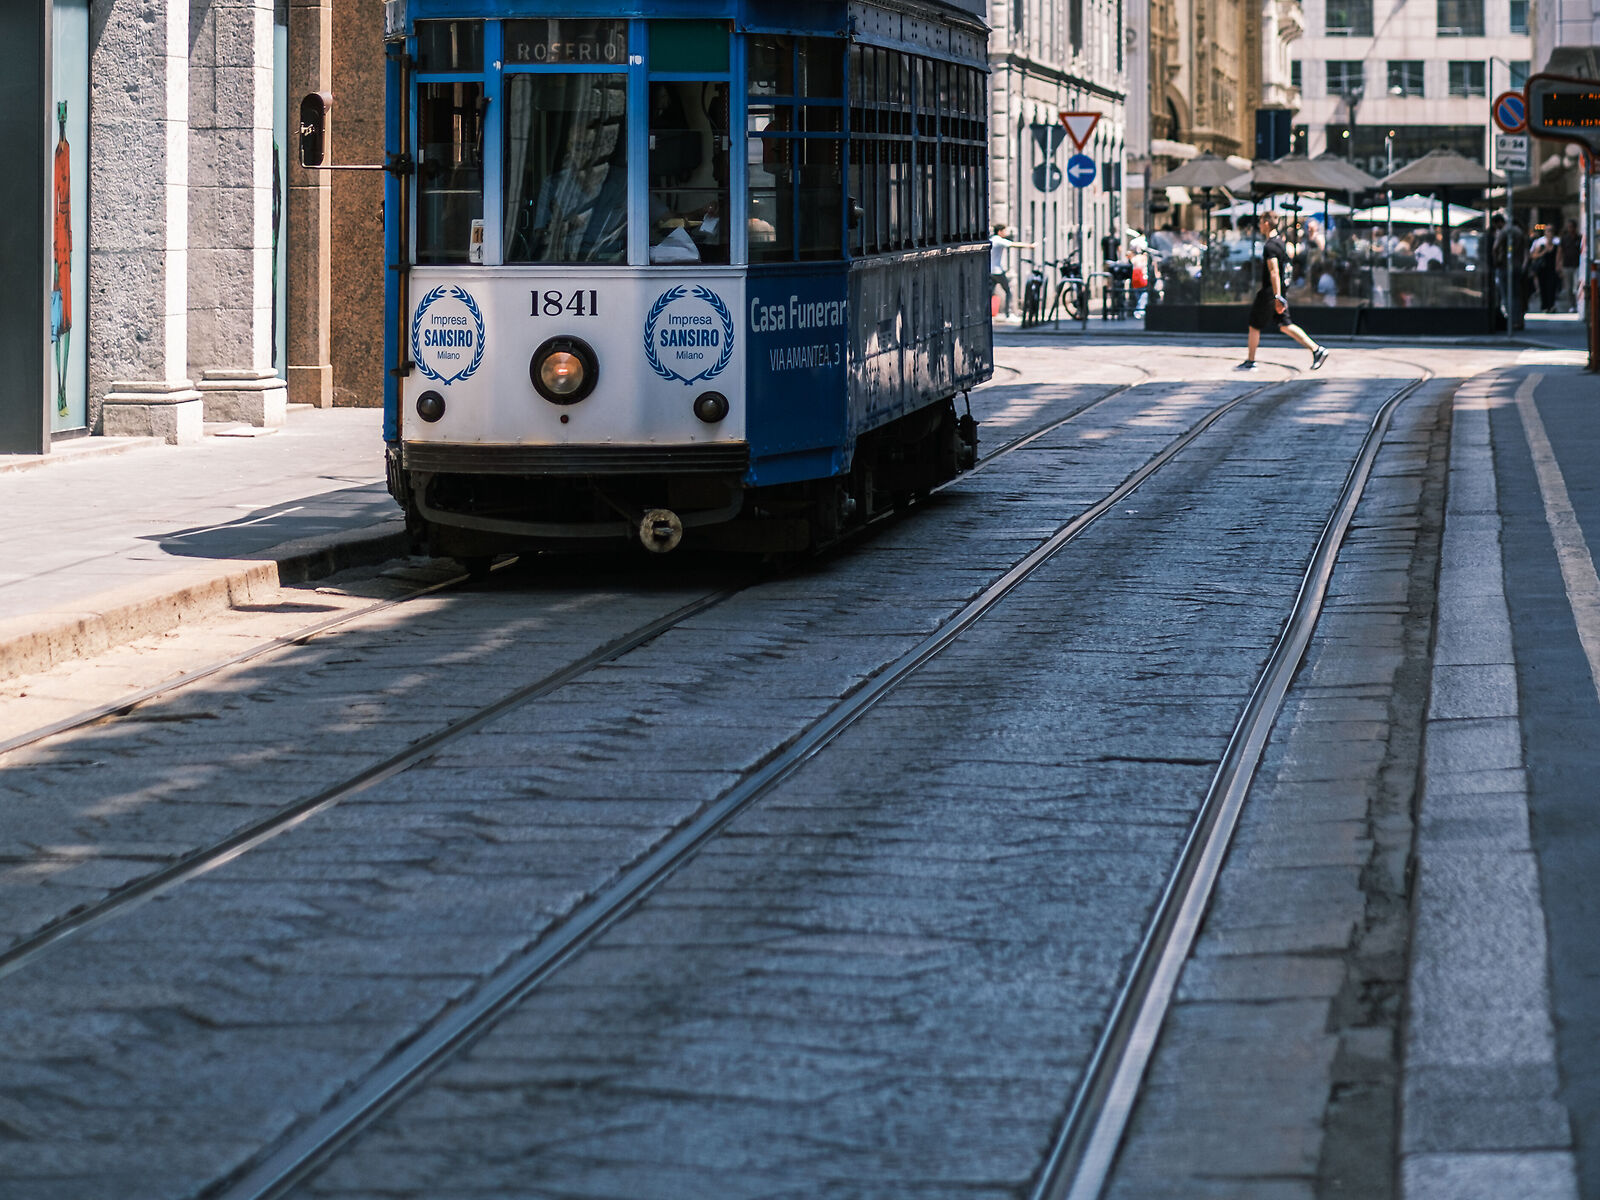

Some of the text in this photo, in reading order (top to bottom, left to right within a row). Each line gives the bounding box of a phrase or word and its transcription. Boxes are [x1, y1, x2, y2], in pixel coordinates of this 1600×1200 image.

[517, 42, 617, 61] ROSERIO
[530, 289, 599, 317] 1841
[431, 313, 468, 328] Impresa
[668, 313, 713, 328] Impresa
[750, 296, 786, 333] Casa
[424, 328, 473, 348] SANSIRO
[660, 328, 720, 348] SANSIRO
[437, 350, 461, 360] Milano
[675, 350, 704, 360] Milano
[769, 347, 786, 372] VIA
[834, 342, 841, 366] 3
